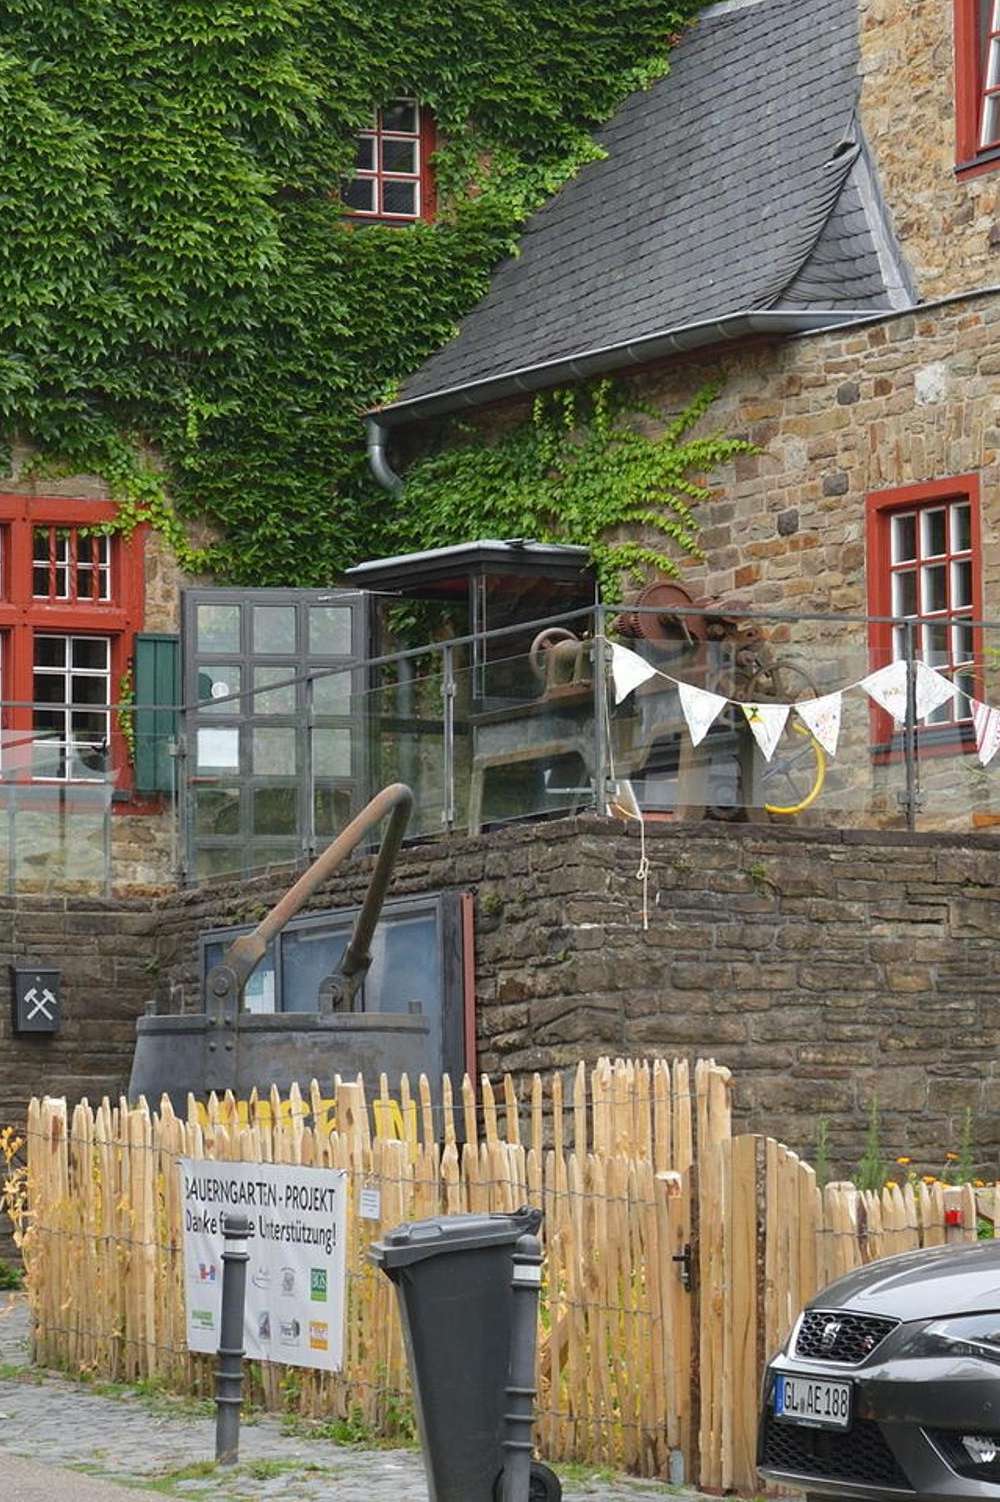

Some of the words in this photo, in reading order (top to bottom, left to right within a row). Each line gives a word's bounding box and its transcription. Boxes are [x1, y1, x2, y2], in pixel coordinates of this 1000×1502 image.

[285, 1185, 336, 1212] PROJEKT
[185, 1207, 218, 1236] Danke
[784, 1381, 799, 1410] GL
